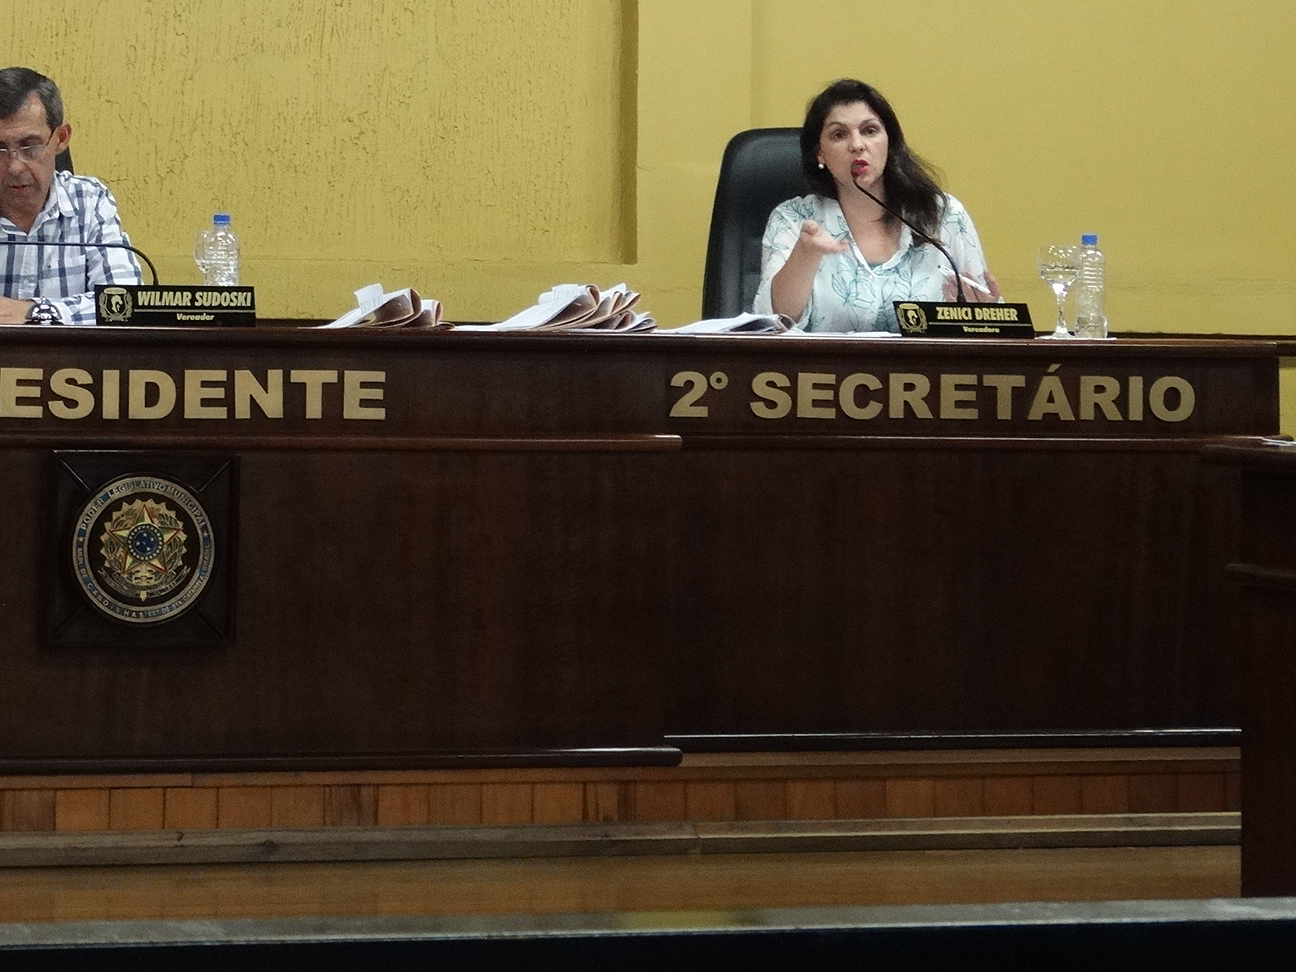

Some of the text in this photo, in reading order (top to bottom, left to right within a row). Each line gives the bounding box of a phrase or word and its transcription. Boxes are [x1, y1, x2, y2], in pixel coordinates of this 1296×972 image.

[137, 291, 252, 307] WILMAR SUDOSKI
[176, 313, 215, 321] Vereador
[935, 306, 1019, 322] ZENICI DREHER
[962, 325, 1000, 333] Vereadora
[750, 364, 1195, 422] SECRETÁRIO
[80, 480, 207, 531] PODER LEGISLATIVO MUNICIPAL
